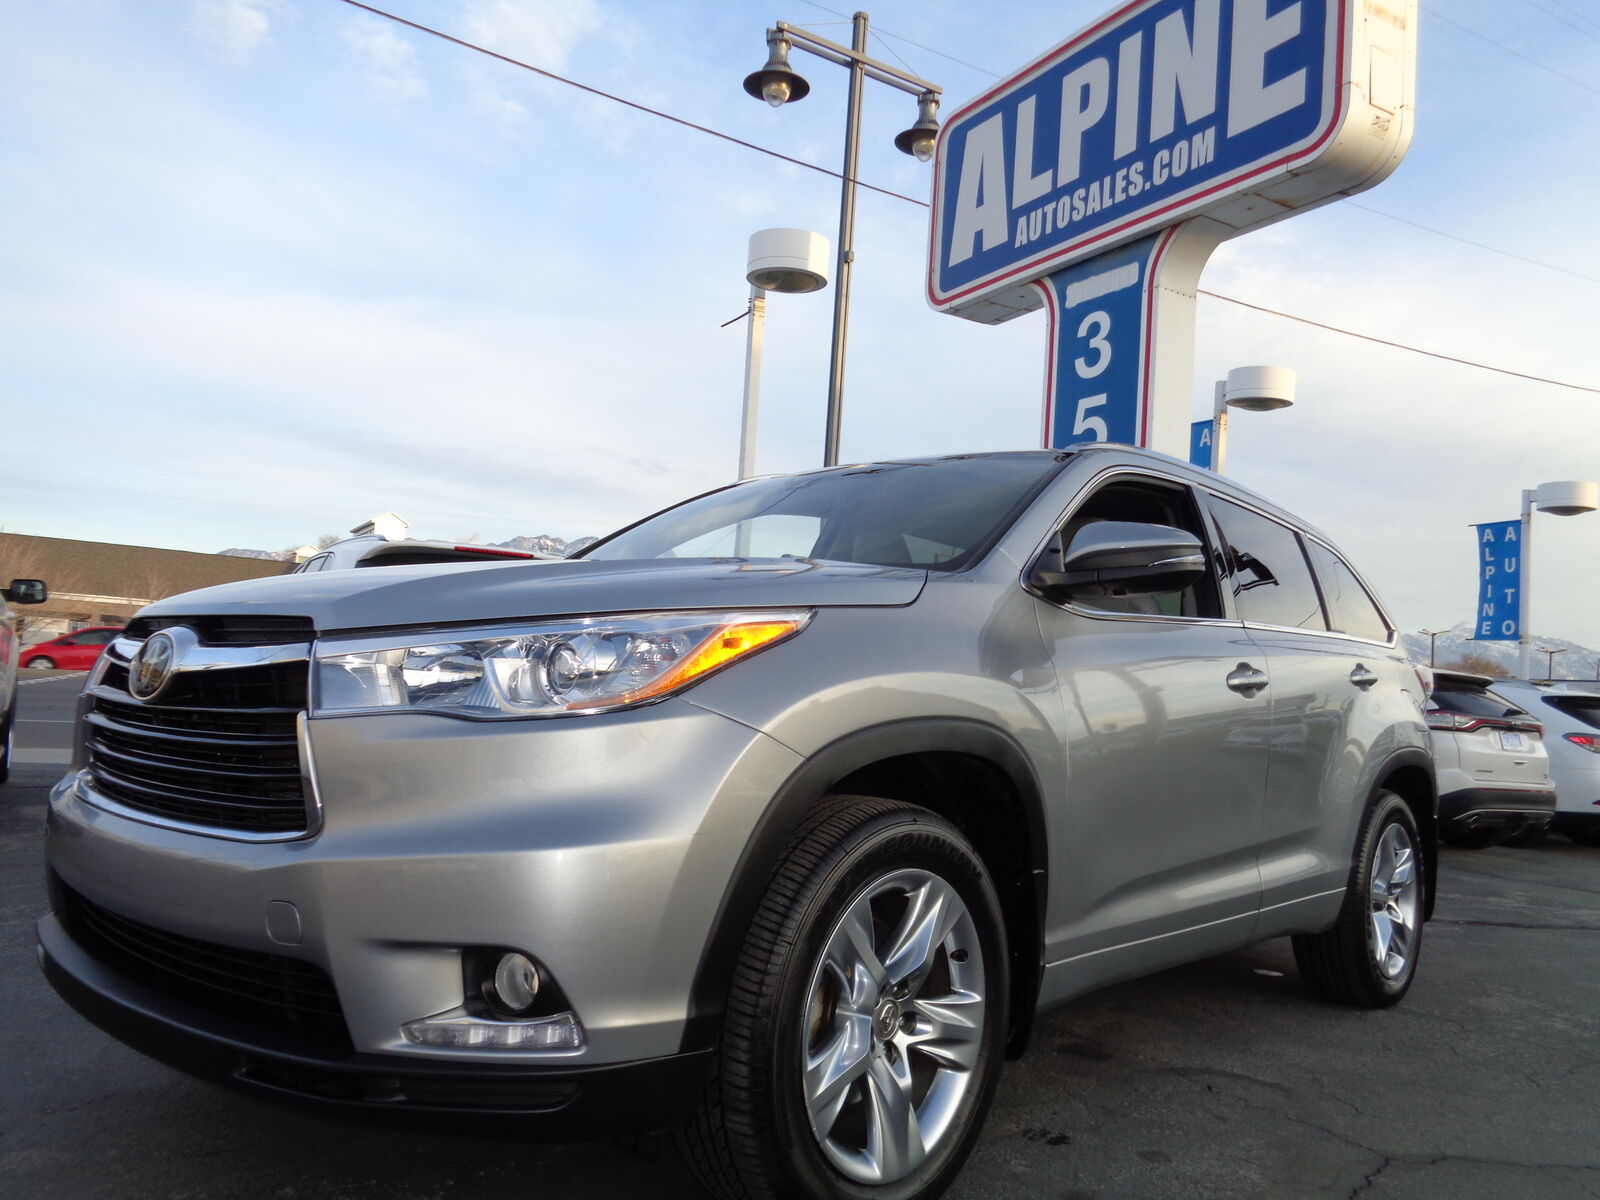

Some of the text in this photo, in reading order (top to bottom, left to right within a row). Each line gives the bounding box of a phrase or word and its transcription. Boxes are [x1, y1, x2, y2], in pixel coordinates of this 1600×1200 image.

[949, 0, 1307, 267] ALPINE
[1014, 126, 1216, 249] AUTOSALES.COM
[1481, 528, 1495, 635] ALPINE
[1501, 526, 1517, 636] AUTO
